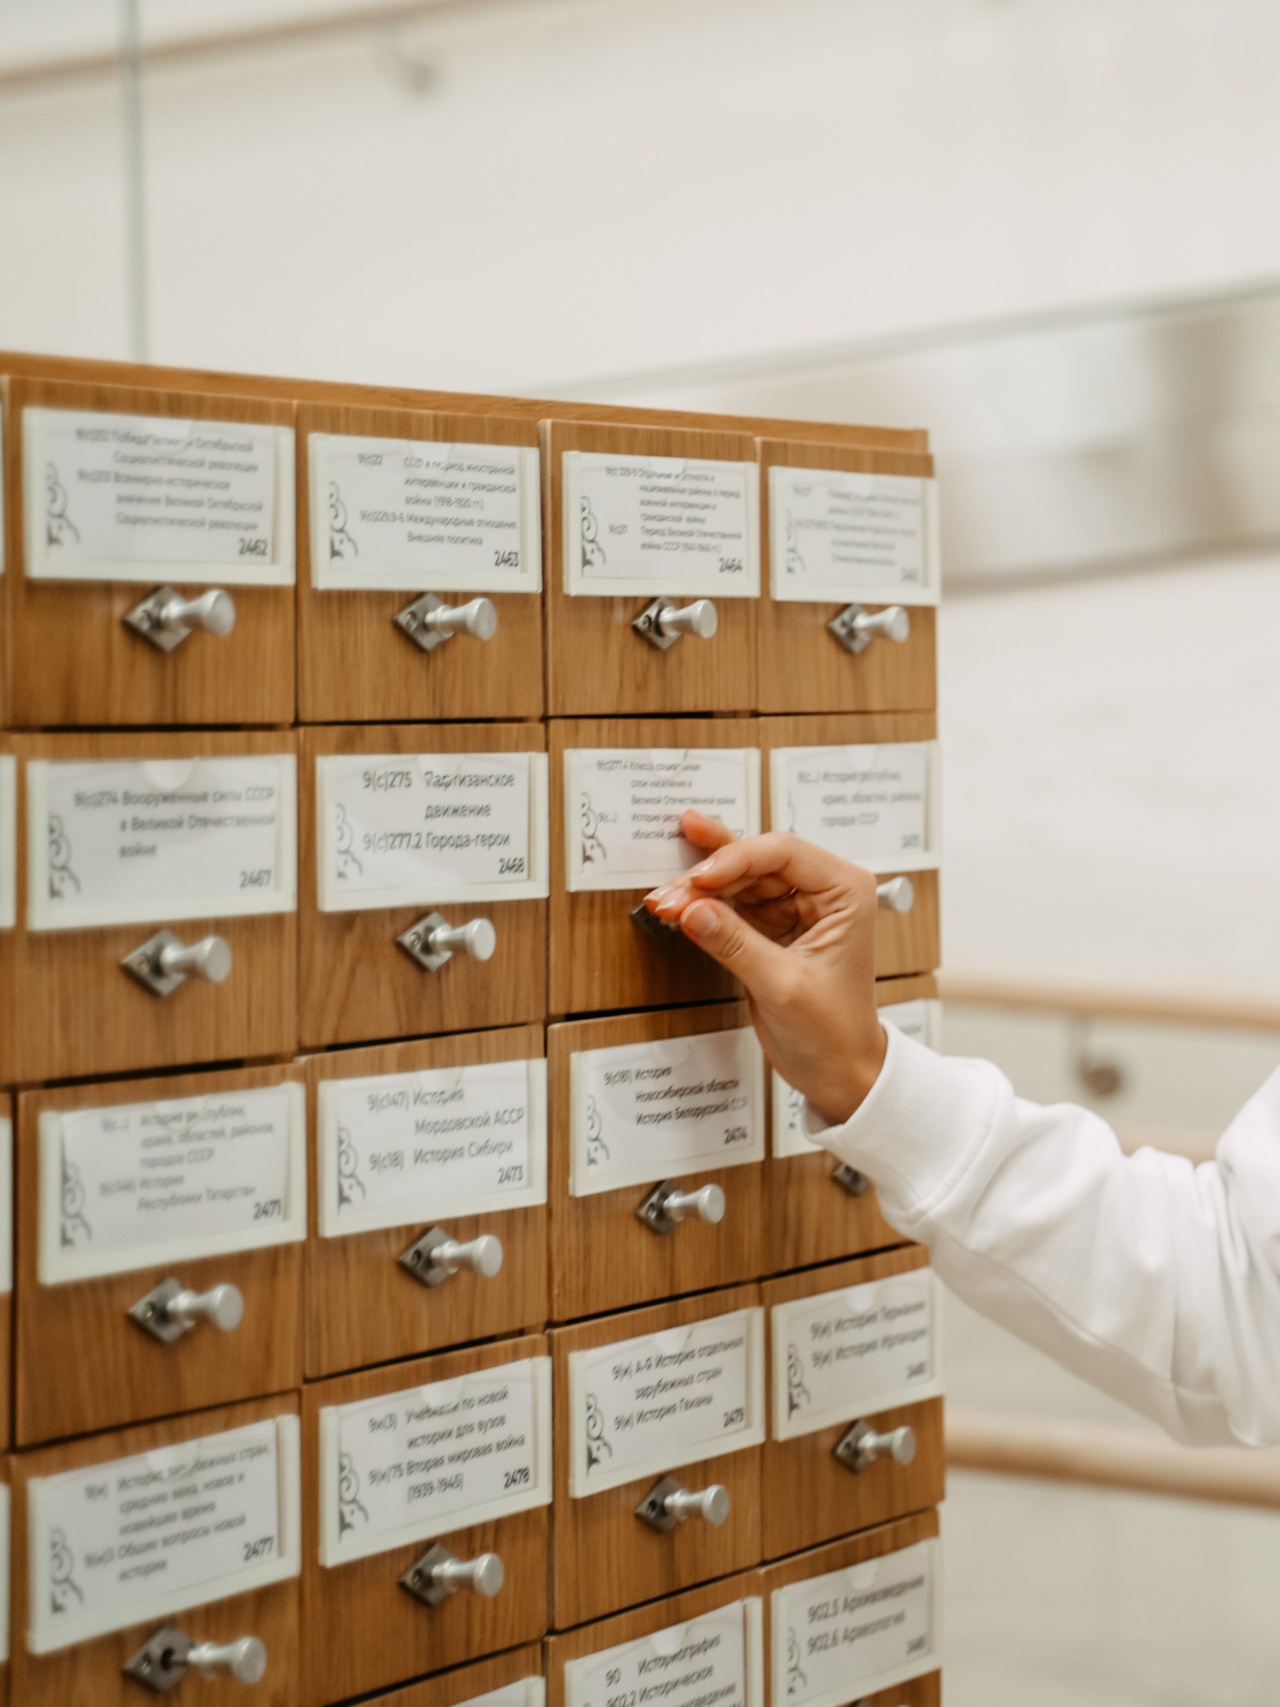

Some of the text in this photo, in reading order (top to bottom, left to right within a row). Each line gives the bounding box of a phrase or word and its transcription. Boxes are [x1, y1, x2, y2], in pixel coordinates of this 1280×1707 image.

[362, 770, 412, 792] 9(с)275
[132, 815, 184, 831] Великой
[188, 811, 275, 829] Отечественной
[425, 803, 491, 820] движение
[426, 832, 511, 852] Города-герои
[635, 1066, 671, 1081] История
[412, 1089, 464, 1107] История
[416, 1108, 524, 1136] Мордовской АССР
[636, 1110, 673, 1125] История
[414, 1146, 464, 1165] История
[468, 1139, 513, 1158] Сибири
[655, 1350, 695, 1369] История
[462, 1399, 475, 1410] по
[477, 1386, 509, 1405] новой
[636, 1405, 676, 1425] История
[408, 1415, 506, 1450] истории для вузов
[407, 1455, 445, 1475] Вторая
[448, 1443, 492, 1465] мировая
[495, 1434, 525, 1452] война
[639, 1665, 713, 1702] Историческое
